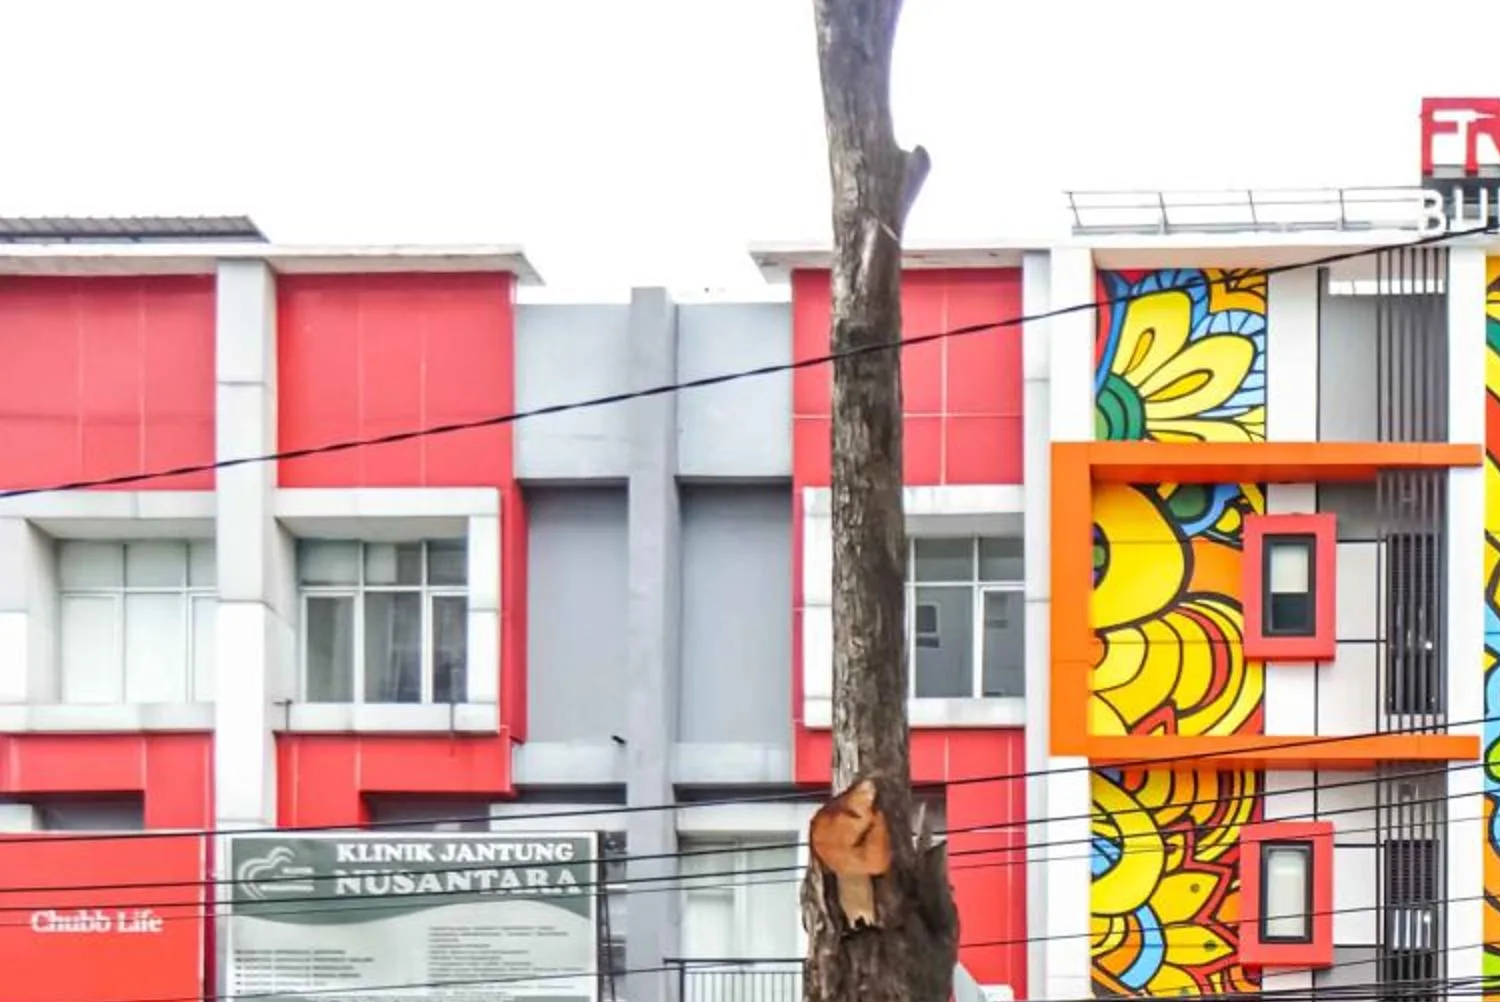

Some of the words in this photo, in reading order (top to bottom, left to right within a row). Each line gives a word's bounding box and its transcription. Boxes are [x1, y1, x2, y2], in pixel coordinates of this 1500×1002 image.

[336, 842, 434, 863] KLINIK
[439, 842, 574, 863] JANTUNG
[334, 867, 582, 895] NUSANTARA
[31, 909, 111, 933] Chubb
[117, 909, 164, 933] Life
